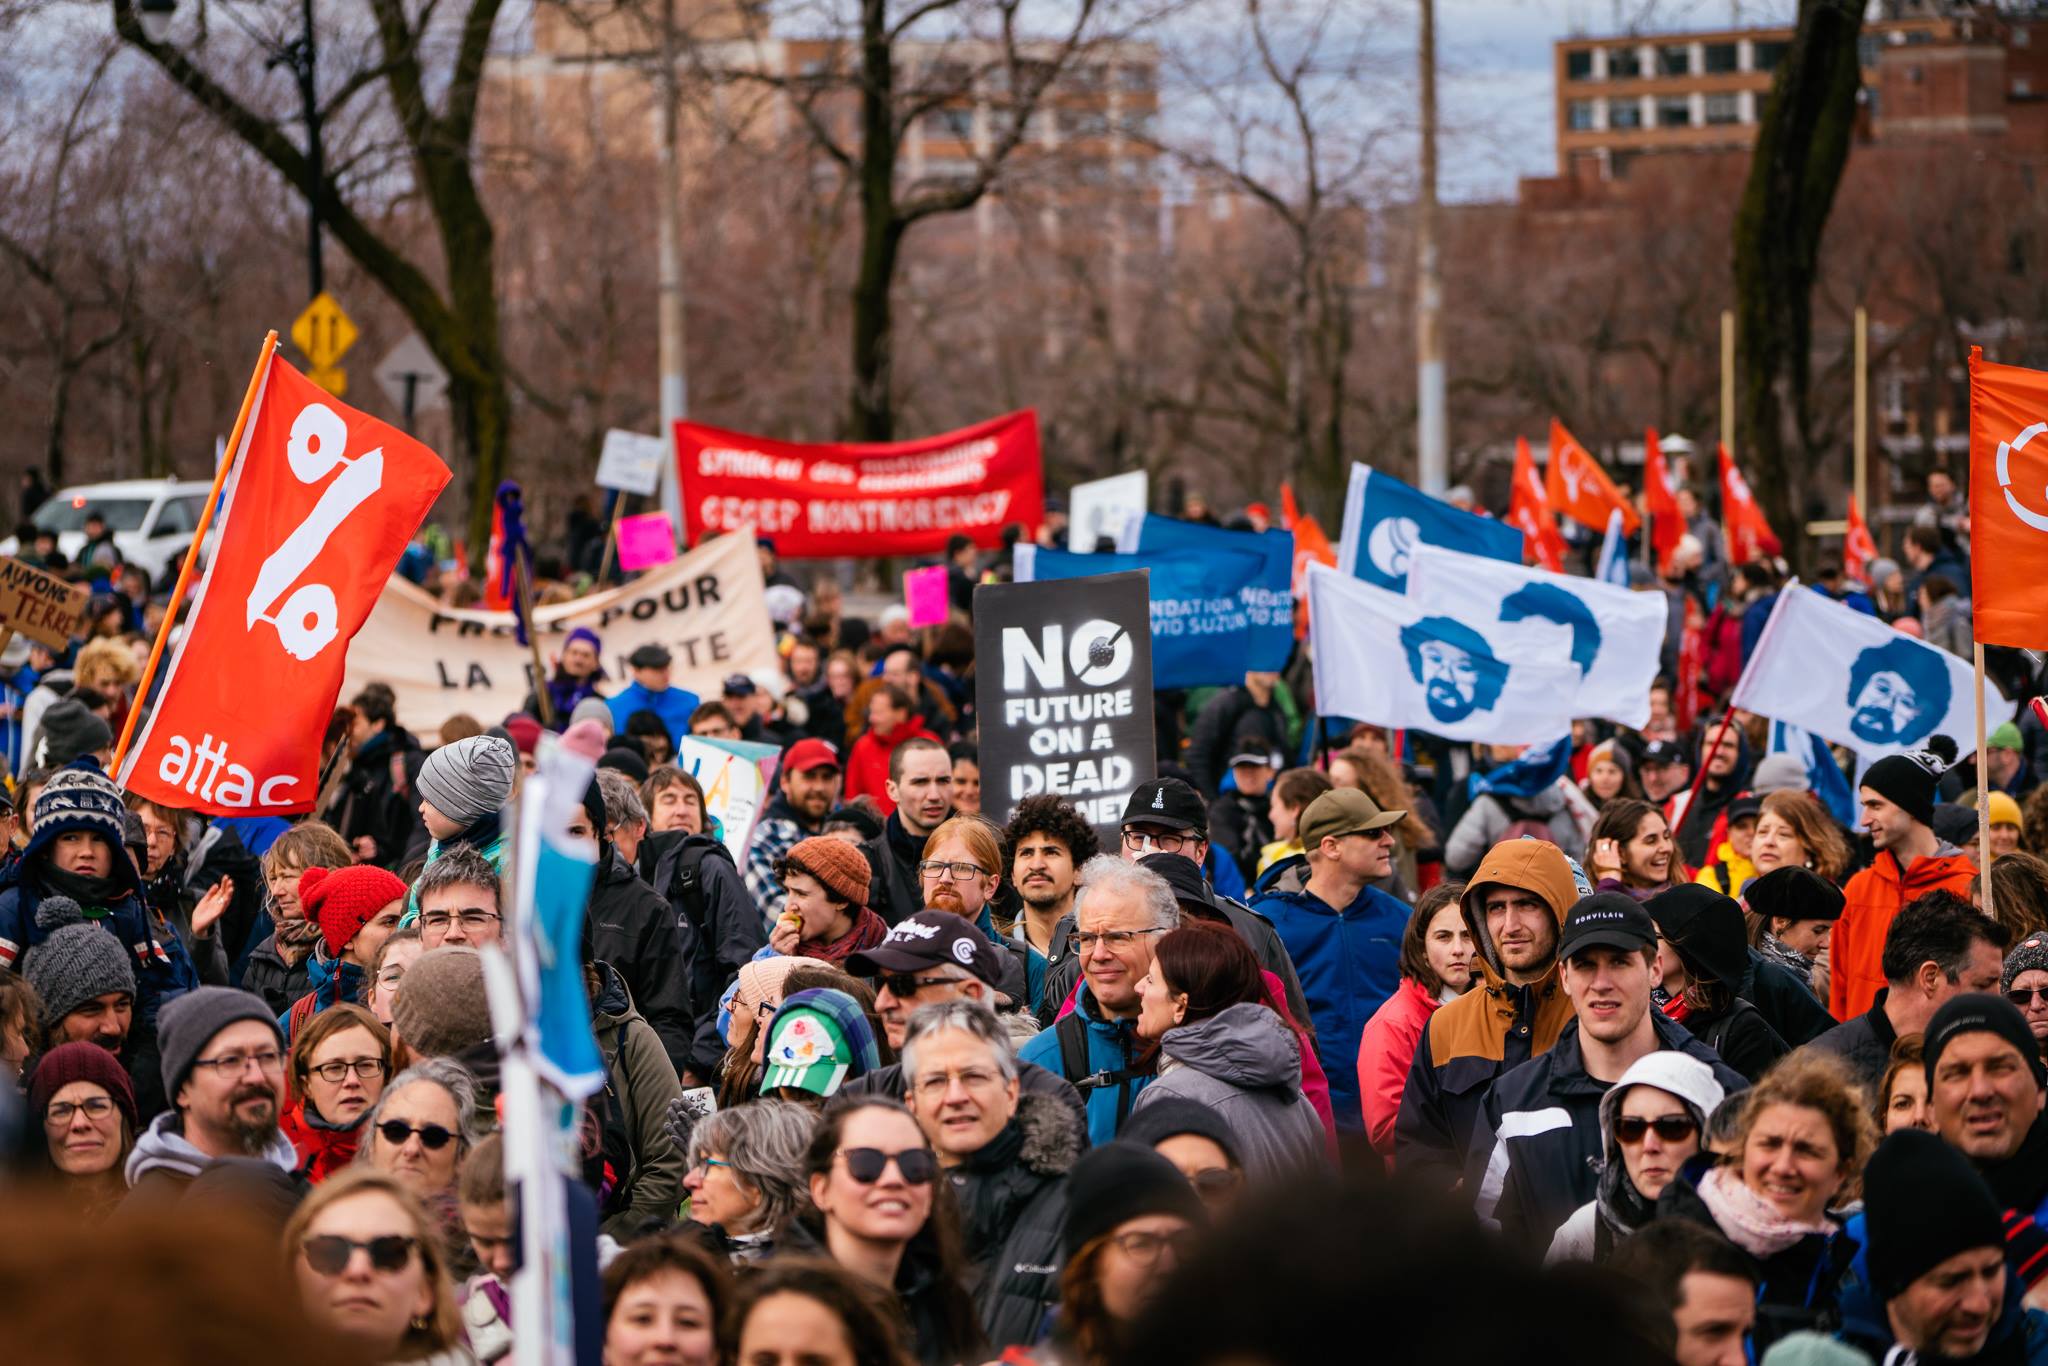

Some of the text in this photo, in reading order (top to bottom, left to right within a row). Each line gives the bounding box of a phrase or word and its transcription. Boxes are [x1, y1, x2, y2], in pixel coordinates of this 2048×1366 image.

[601, 574, 721, 629] POUR
[1149, 598, 1235, 617] NDATION
[1151, 617, 1184, 636] VID
[1002, 619, 1133, 690] NO
[437, 658, 492, 691] LA
[1005, 689, 1133, 725] FUTURE
[1029, 723, 1114, 756] ON A
[159, 733, 299, 808] attac
[1010, 755, 1132, 800] DEAD
